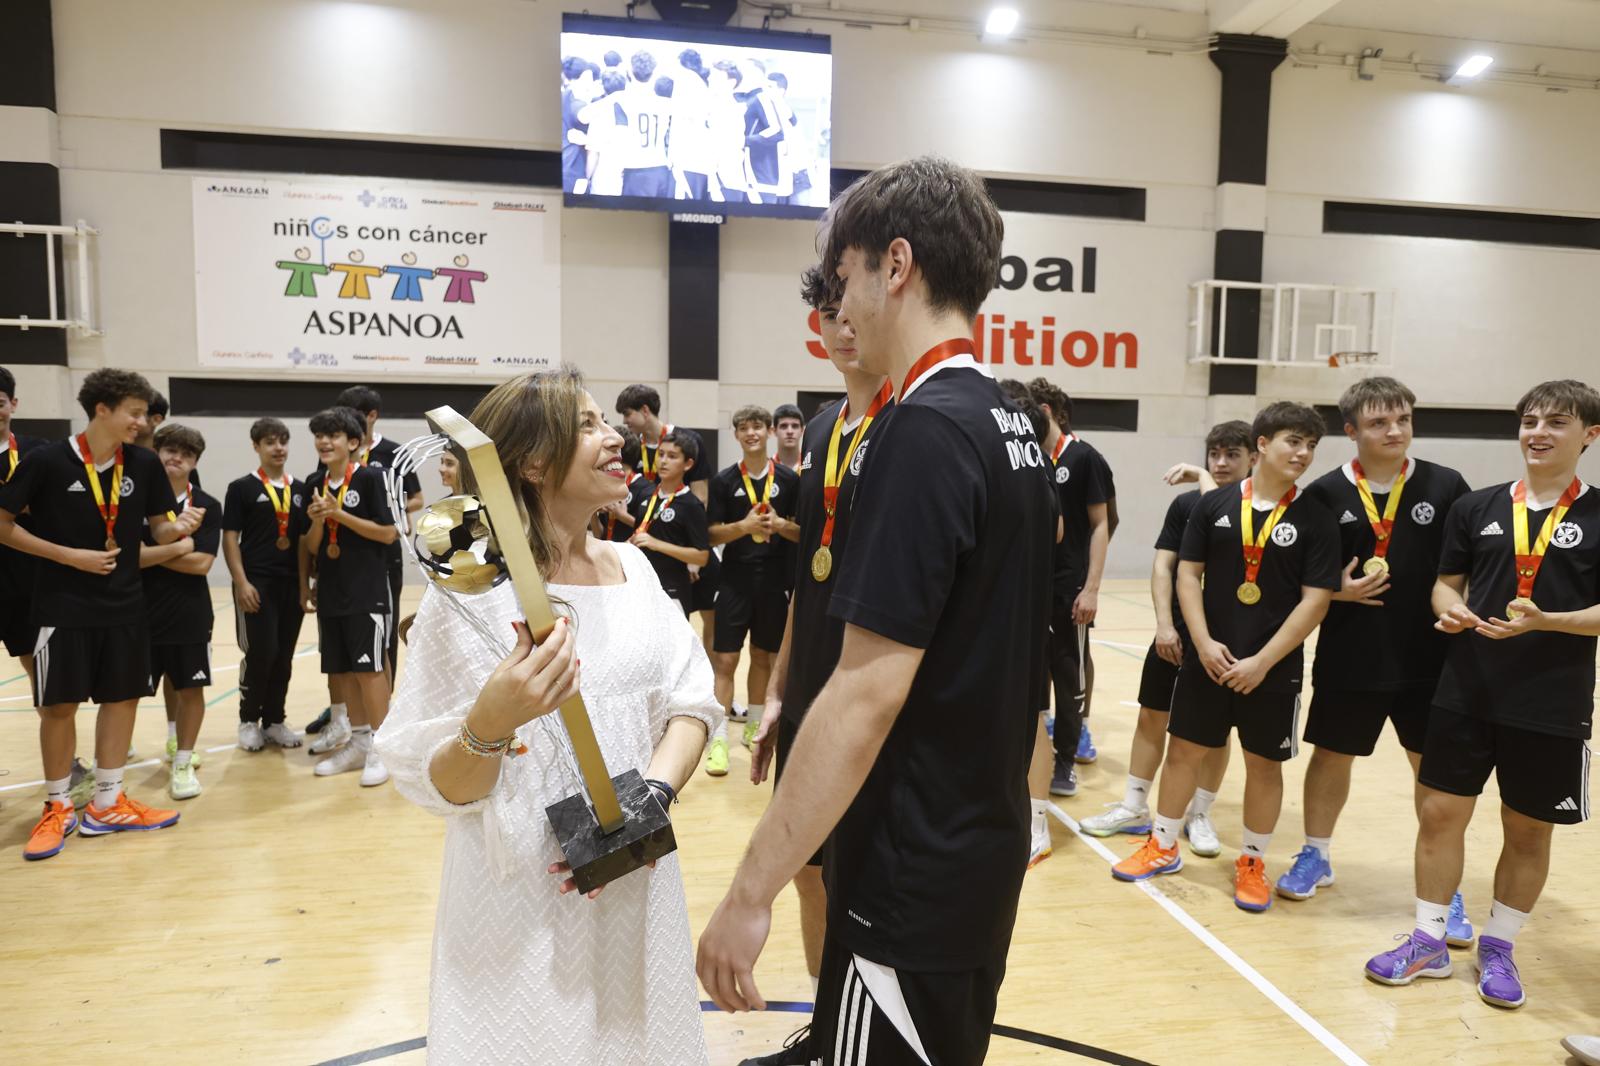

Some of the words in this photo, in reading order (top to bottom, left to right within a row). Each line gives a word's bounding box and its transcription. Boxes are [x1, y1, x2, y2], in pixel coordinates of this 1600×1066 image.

[222, 186, 269, 195] ANAGAN
[681, 213, 723, 224] MONDO
[357, 225, 400, 241] con
[409, 225, 488, 245] cáncer
[993, 247, 1097, 294] bal
[303, 310, 464, 339] ASPANOA
[506, 357, 549, 366] ANAGAN
